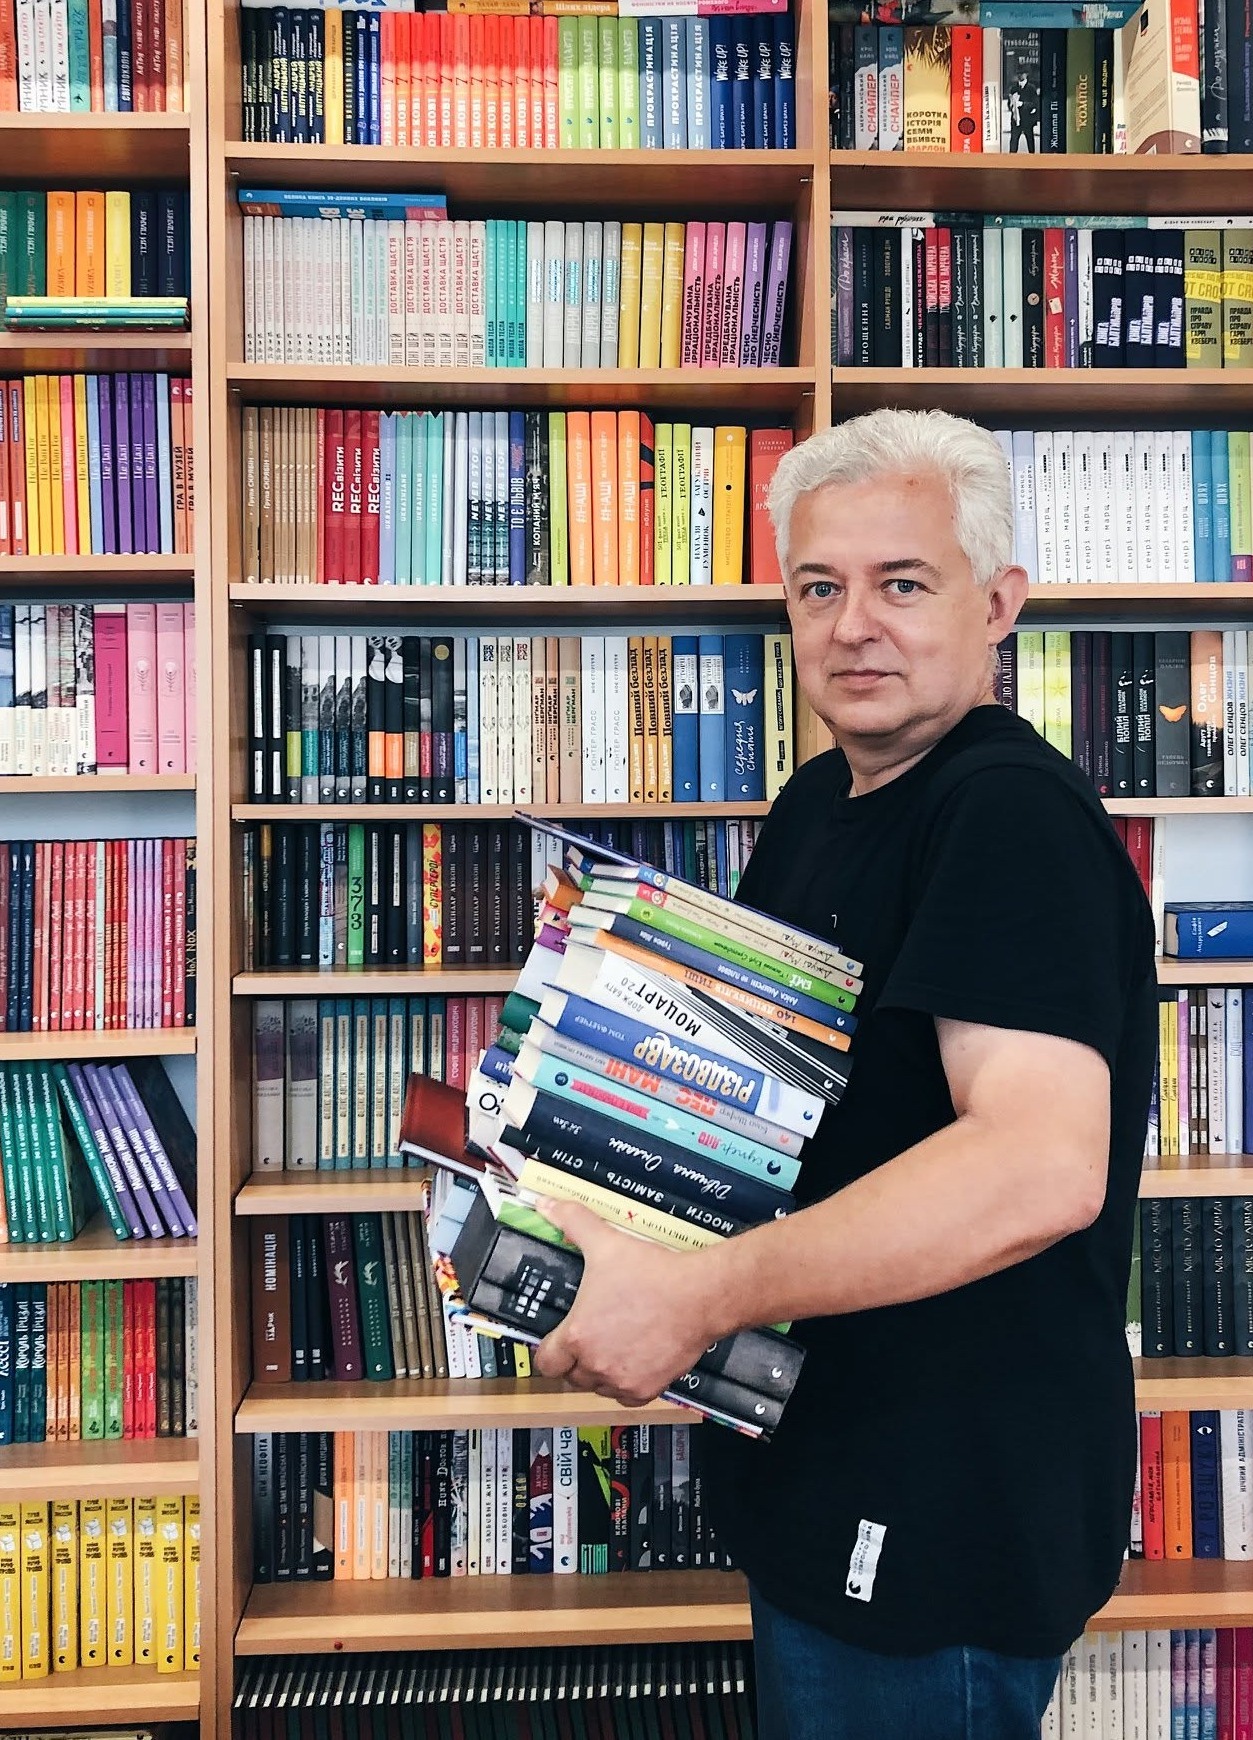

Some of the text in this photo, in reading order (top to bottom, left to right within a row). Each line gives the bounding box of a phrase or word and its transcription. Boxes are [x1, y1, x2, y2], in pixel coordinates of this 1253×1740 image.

[280, 58, 288, 112] ШЕПТИЦЬКИЙ
[382, 77, 393, 85] 7
[646, 26, 654, 127] ПРОКРАСТИНАЦІЯ
[671, 24, 679, 124] ПРОКРАСТИНАЦІЯ
[714, 45, 728, 81] WAKE UP!
[867, 74, 876, 132] СНАЙПЕР
[891, 74, 899, 132] СНАЙПЕР
[1051, 102, 1057, 110] Пі
[1078, 75, 1088, 127] компас
[1101, 89, 1107, 97] ЦЕ
[1101, 99, 1107, 107] ЧИ
[407, 237, 415, 266] ЩАСТЯ
[838, 233, 852, 290] До краси
[390, 238, 402, 348] ШЕЙ ДОСТАВКА ЩАСТЯ
[927, 246, 937, 313] ТОКІЙСЬКА НАРЕЧЕНА
[684, 285, 693, 363] ПЕРЕДБАЧУВАНА
[692, 276, 701, 363] ІРРАЦІОНАЛЬНІСТЬ
[705, 283, 714, 361] ПЕРЕДБАЧУВАНА
[712, 275, 721, 361] ІРРАЦІОНАЛЬНІСТЬ
[751, 282, 761, 343] (НЕ)ЧЕСНІСТЬ
[772, 281, 785, 342] (НЕ)ЧЕСНІСТЬ
[1097, 322, 1109, 344] КНИГА
[407, 333, 419, 347] ШЕЙ
[440, 333, 451, 347] ШЕЙ
[763, 333, 771, 363] ЧЕСНО
[175, 446, 183, 480] МУЗЕЙ
[247, 458, 255, 487] СКРЯБІН
[332, 447, 344, 512] RECвізити
[659, 449, 667, 498] ГЕОГРАФІЇ
[511, 478, 524, 506] ЛЬВІВ
[1198, 483, 1208, 504] ШЛЯХ
[511, 519, 524, 529] ТО
[1044, 541, 1052, 571] генрі
[629, 649, 644, 736] Повний безлад
[644, 649, 658, 736] Повний безлад
[1198, 682, 1207, 712] Олег
[1208, 656, 1216, 702] Сенцов
[429, 860, 438, 908] СУПЕРГЕРОЇ
[603, 980, 644, 1013] ДОРЖ БАТУ
[682, 968, 714, 990] ТИШІ
[573, 1013, 626, 1041] ТОМ ФЛЕТЧЕР
[633, 981, 703, 1037] МОЦАРТ
[775, 1008, 798, 1026] 140
[603, 1057, 662, 1093] МАНІ
[633, 1032, 755, 1102] РІЗДВОЗАВР
[674, 1086, 719, 1117] ПЕС
[551, 1147, 734, 1232] МОСТИ ЗАМІСТЬ СТІН
[604, 1137, 732, 1201] Дівчина Онлайн
[265, 1234, 277, 1291] НОМІНАЦІЯ
[259, 1438, 267, 1475] НЕОФІТА
[557, 1453, 572, 1487] свій
